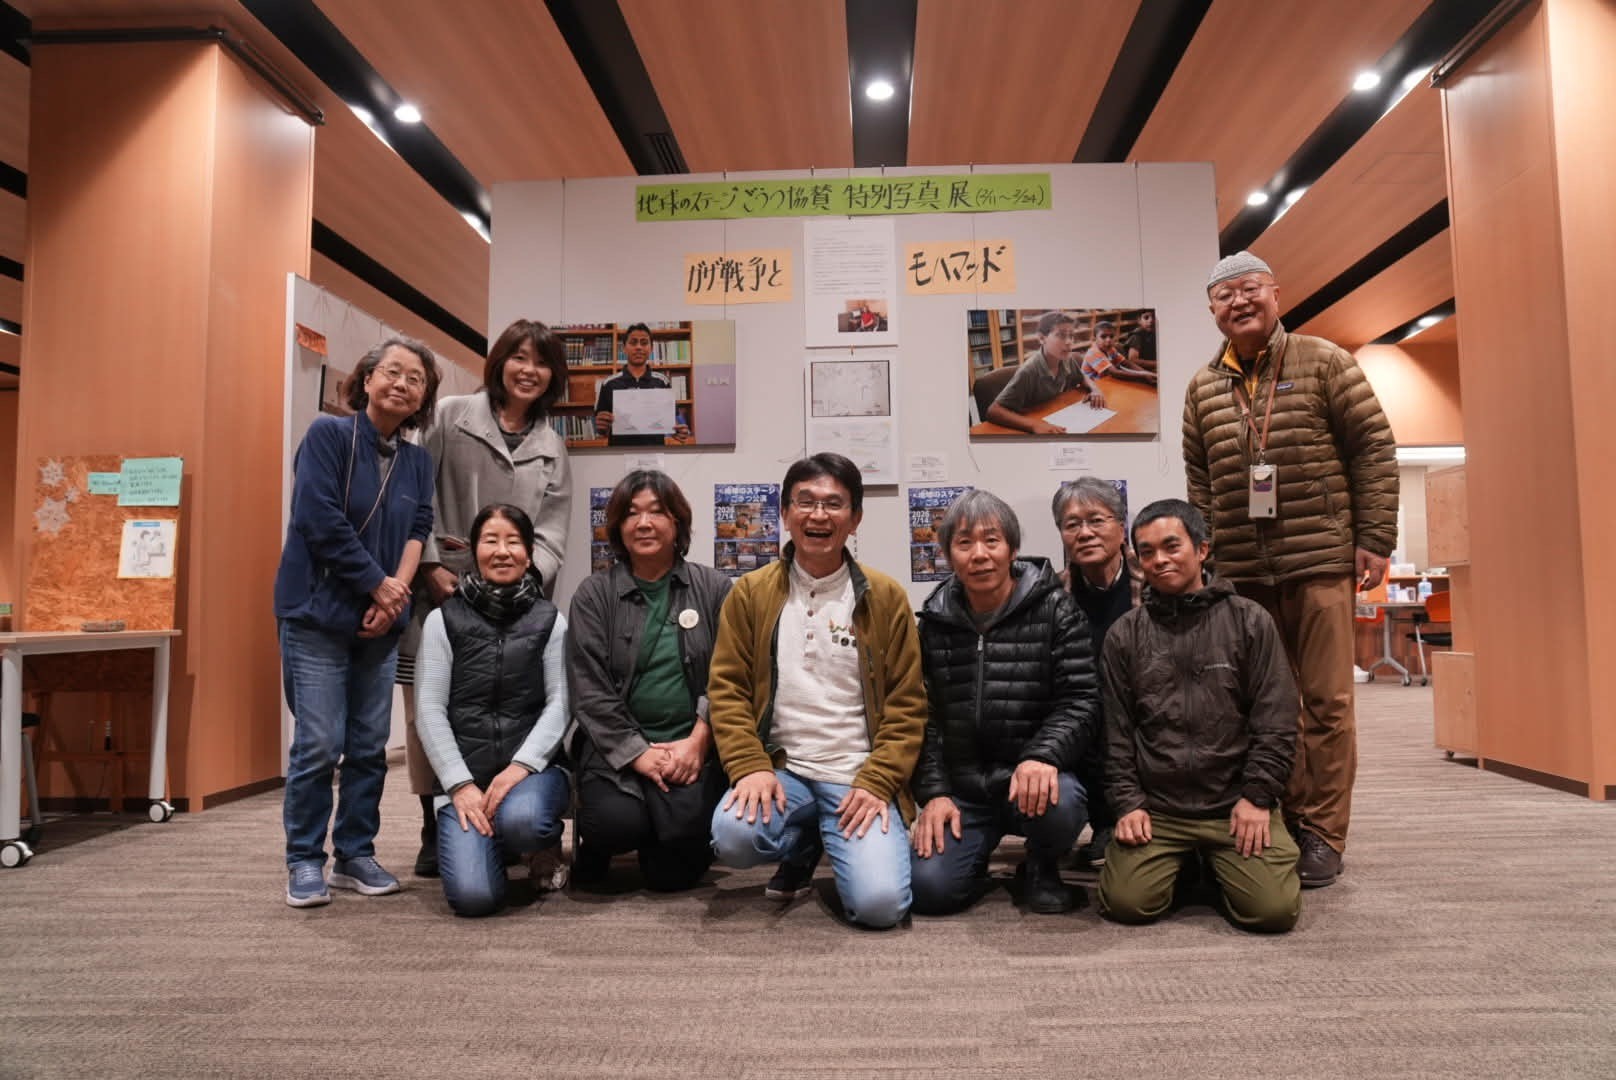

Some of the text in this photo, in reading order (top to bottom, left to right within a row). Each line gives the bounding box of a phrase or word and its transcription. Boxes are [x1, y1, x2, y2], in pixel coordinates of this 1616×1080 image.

[688, 256, 784, 294] ガザ戦争と
[908, 245, 1006, 287] モハマッド
